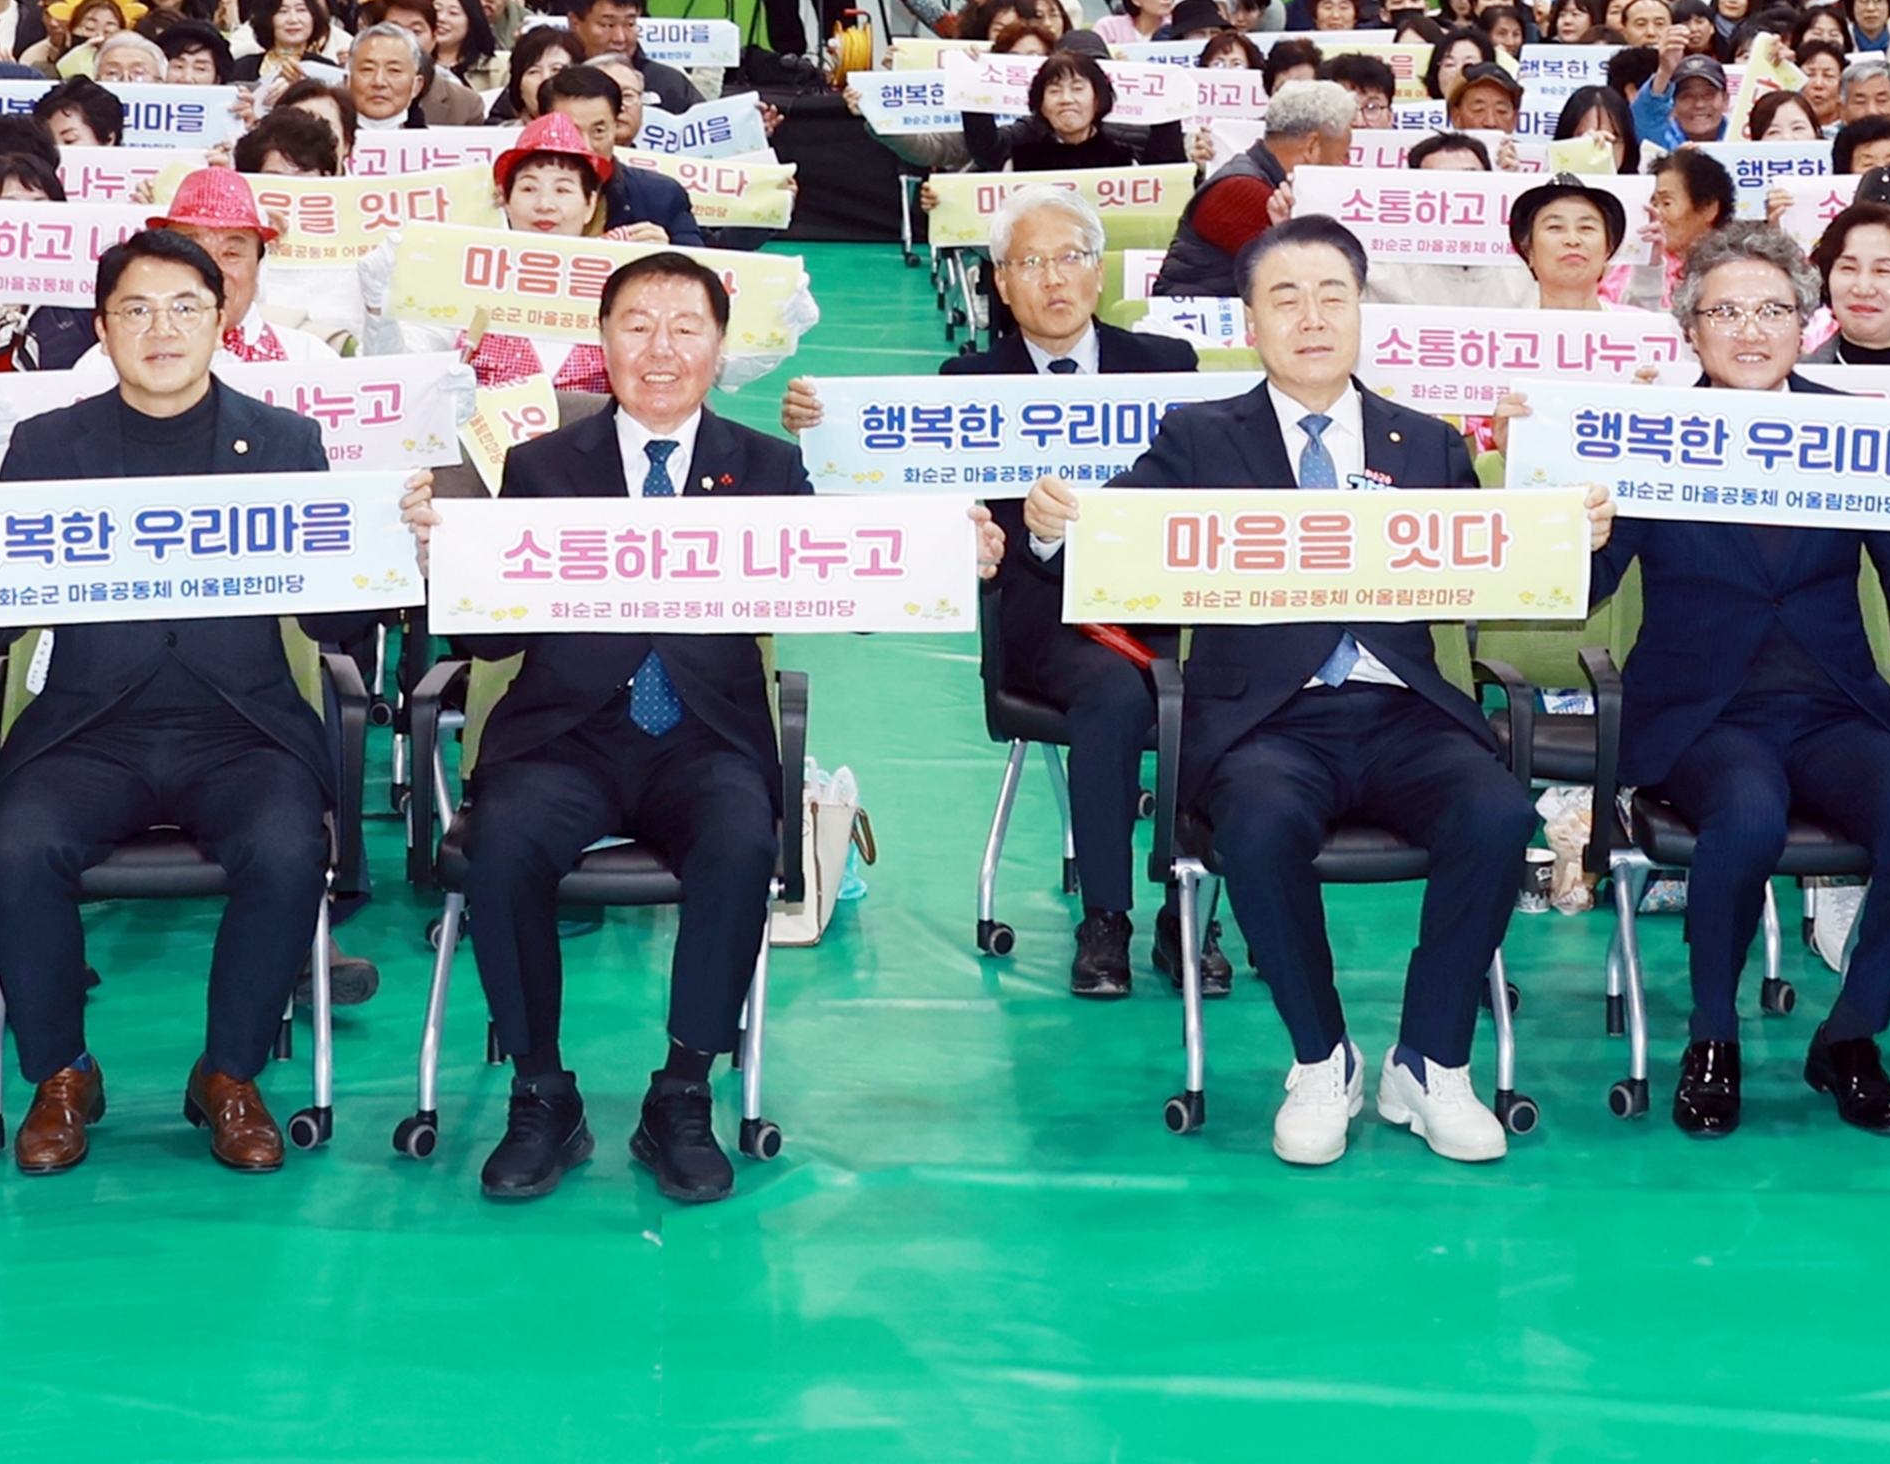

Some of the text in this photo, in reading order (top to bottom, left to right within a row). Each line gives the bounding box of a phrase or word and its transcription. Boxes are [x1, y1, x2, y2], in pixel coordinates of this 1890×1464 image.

[981, 63, 1165, 96] 소통 누고
[123, 98, 208, 132] 리마을
[642, 116, 734, 151] 우리마을
[679, 164, 749, 197] 잇다
[1097, 178, 1163, 207] 잇다
[360, 188, 450, 230] 잇다
[1341, 187, 1485, 226] 소통하고
[1371, 237, 1486, 254] 화순군 마을공동체
[464, 245, 614, 295] 마음을
[1375, 327, 1540, 370] 소통하고
[1410, 382, 1459, 401] 화순군
[861, 403, 1005, 453] 행복한
[1575, 408, 1731, 466] 행복한
[903, 464, 1132, 485] 화순군 마을공동체 어울림한
[1615, 480, 1675, 504] 화순군
[1682, 484, 1780, 508] 마을공동체
[133, 500, 353, 559] 우리마을
[1166, 514, 1510, 571] 마음을 잇다
[501, 527, 906, 583] 소통하고 나누고
[68, 580, 172, 605] 마을공동체
[180, 574, 305, 600] 어울림한마당
[1182, 585, 1475, 610] 화순군 마을공동체 어울림한마당
[549, 596, 857, 620] 화순군 마을공동체 어울림한마당
